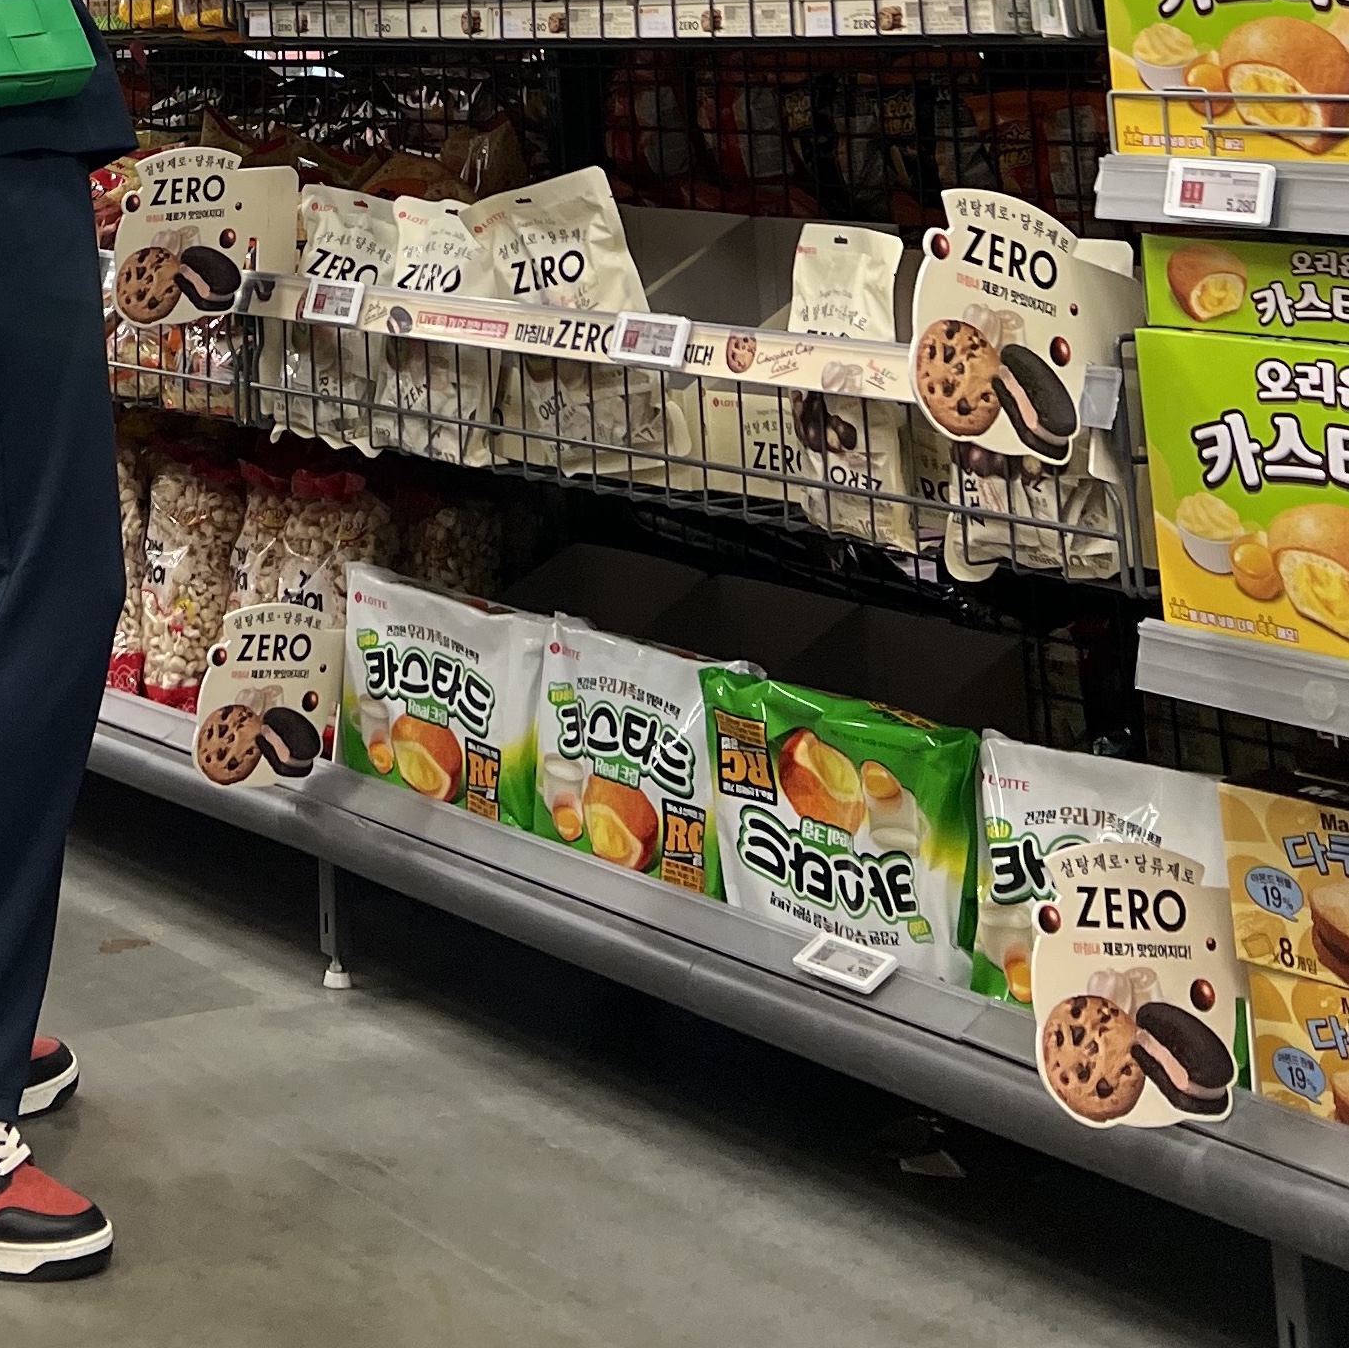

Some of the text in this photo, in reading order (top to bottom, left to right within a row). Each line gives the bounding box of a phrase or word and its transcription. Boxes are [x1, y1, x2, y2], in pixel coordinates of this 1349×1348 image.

[145, 155, 234, 176] 설탕제로·당류제로
[150, 174, 225, 206] ZERO
[955, 197, 1070, 254] 설탕제로·당류제로
[306, 248, 379, 286] ZERO
[963, 225, 1058, 290] ZERO
[398, 264, 461, 293] ZERO
[981, 279, 1009, 301] 제로가
[1010, 286, 1057, 318] 맛있어지다!
[515, 323, 552, 346] 마침내
[363, 597, 388, 610] LOTTE
[234, 610, 322, 631] 설탕제로·당류제로
[237, 633, 312, 662] ZERO
[364, 645, 493, 734] 카스타드
[598, 676, 617, 694] 우리
[618, 680, 646, 702] 가족을
[559, 698, 693, 795] 카스타드
[468, 753, 499, 788] RC
[595, 757, 639, 787] Real 크림
[722, 750, 773, 788] RC
[987, 773, 1030, 792] LOTTE
[802, 819, 826, 844] 크림
[1024, 810, 1056, 826] 건강한
[1059, 808, 1089, 825] 우리
[665, 815, 702, 853] RC
[740, 808, 919, 922] 카스타드
[1060, 853, 1195, 885] 설탕제로·당류제로
[1076, 886, 1186, 933] ZERO
[1261, 886, 1294, 911] 19%
[1102, 942, 1134, 957] 제로가
[1136, 943, 1192, 960] 맛있어지다!
[1287, 1064, 1317, 1092] 19%
